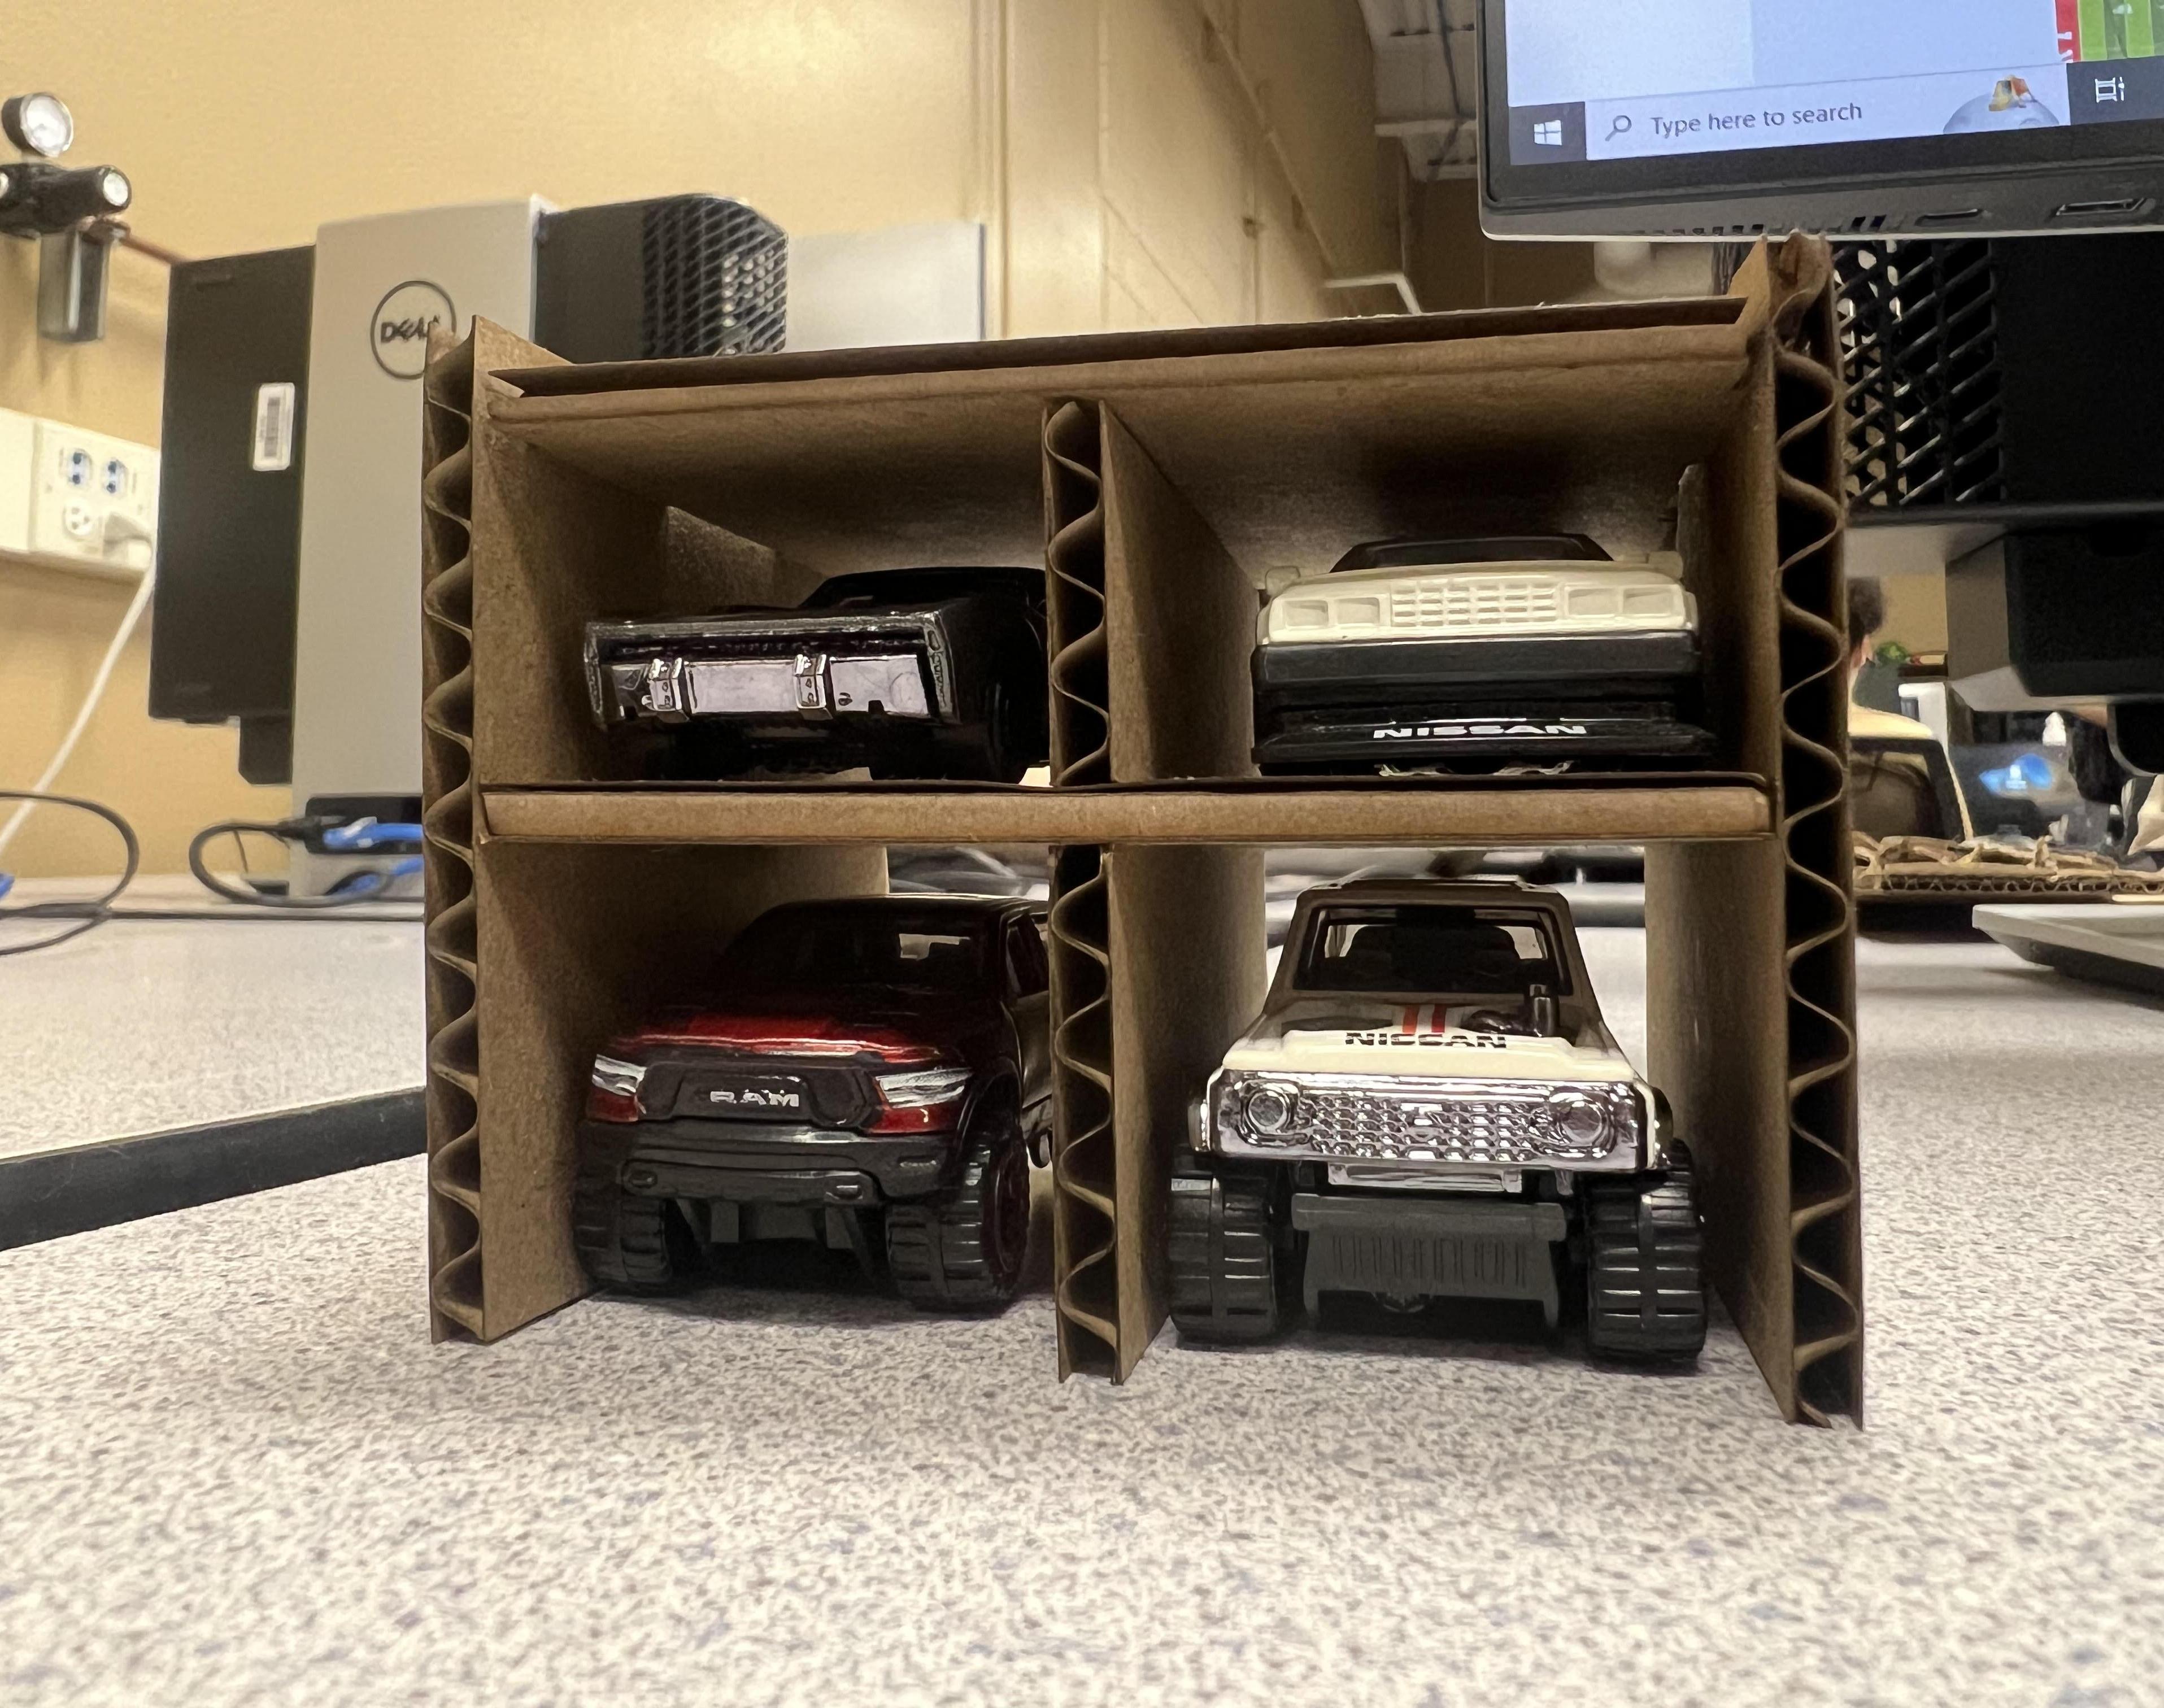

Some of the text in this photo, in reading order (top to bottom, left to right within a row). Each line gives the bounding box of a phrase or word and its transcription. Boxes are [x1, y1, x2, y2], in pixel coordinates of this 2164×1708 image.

[1650, 102, 1862, 139] Type here to search
[1373, 725, 1587, 738] NISSAN
[1345, 1032, 1506, 1048] NISSAN
[710, 1090, 799, 1108] RAM
